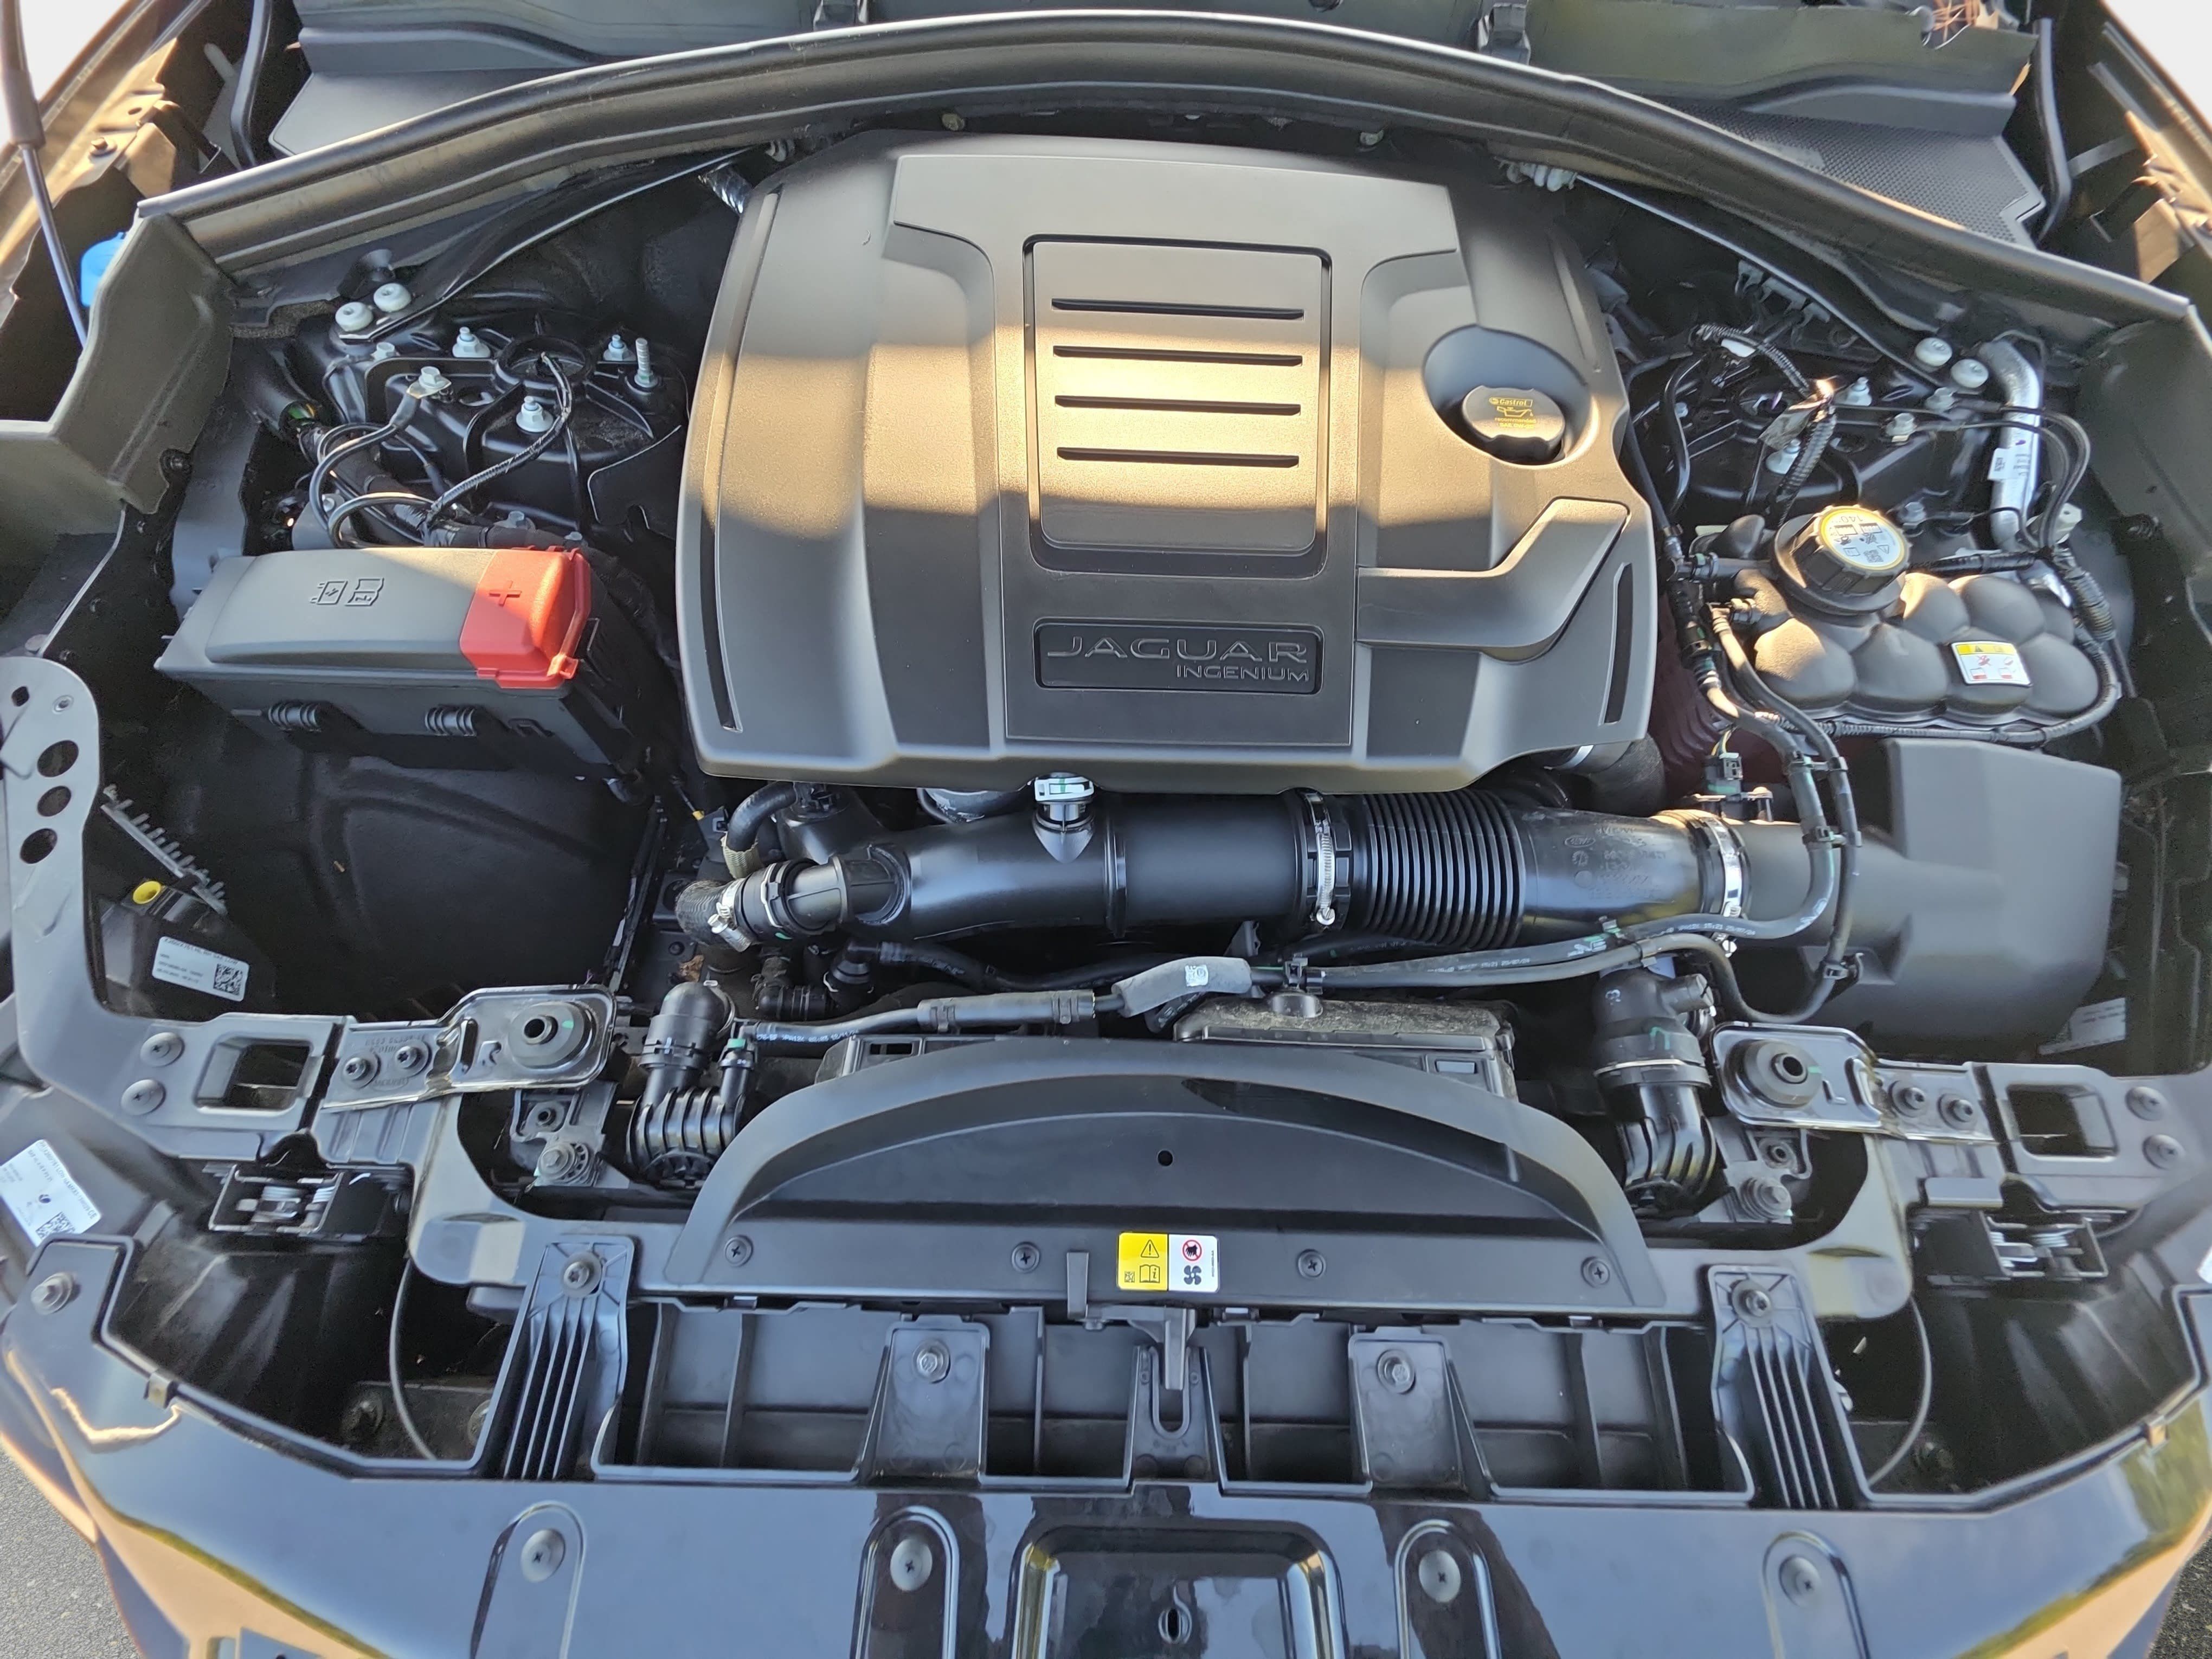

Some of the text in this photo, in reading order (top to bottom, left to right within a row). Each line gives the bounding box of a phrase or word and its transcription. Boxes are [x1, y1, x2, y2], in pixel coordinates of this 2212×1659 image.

[1500, 398, 1527, 406] Castrol
[1047, 636, 1308, 664] JAGUAR
[1176, 664, 1309, 682] INGENIUM
